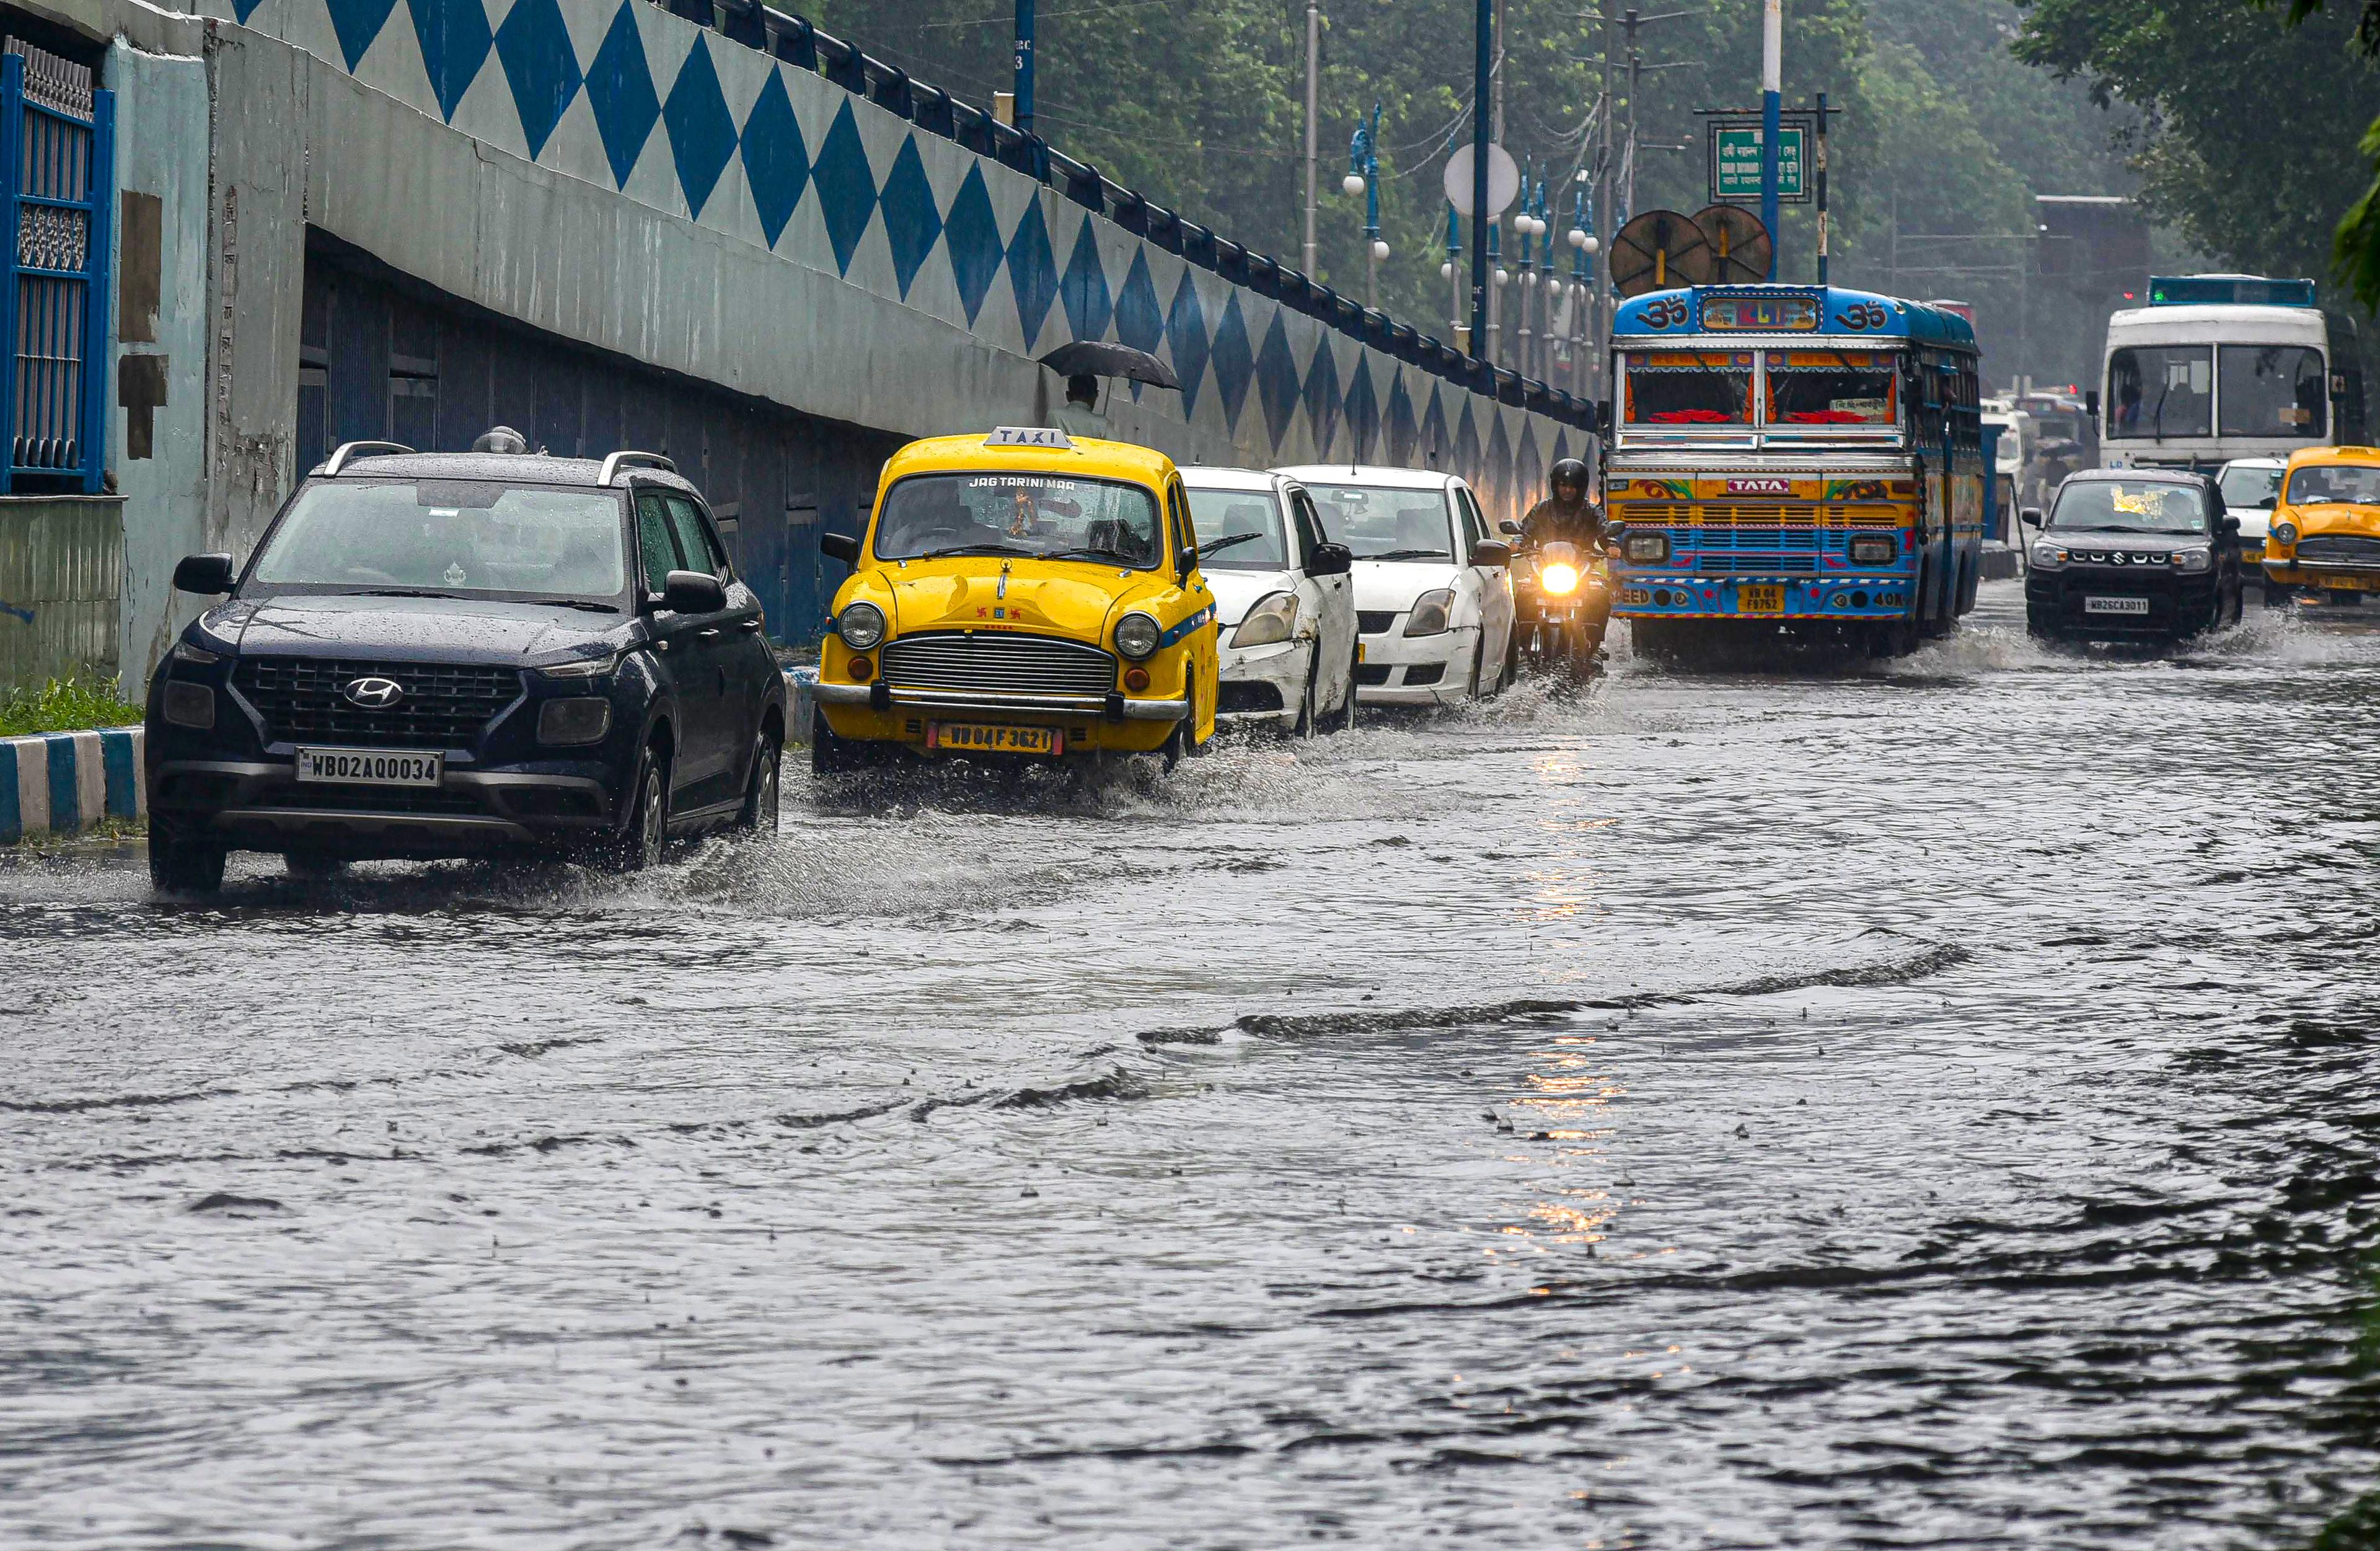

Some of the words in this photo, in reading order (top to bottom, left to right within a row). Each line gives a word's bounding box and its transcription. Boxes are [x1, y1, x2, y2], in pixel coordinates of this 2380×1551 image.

[1015, 55, 1023, 69] 3
[1000, 430, 1055, 443] TAXI
[969, 477, 998, 487] JAG
[999, 477, 1044, 488] TARINI
[1046, 479, 1075, 490] MAA
[1734, 480, 1783, 490] TATA
[312, 754, 436, 780] WB02AQ0034
